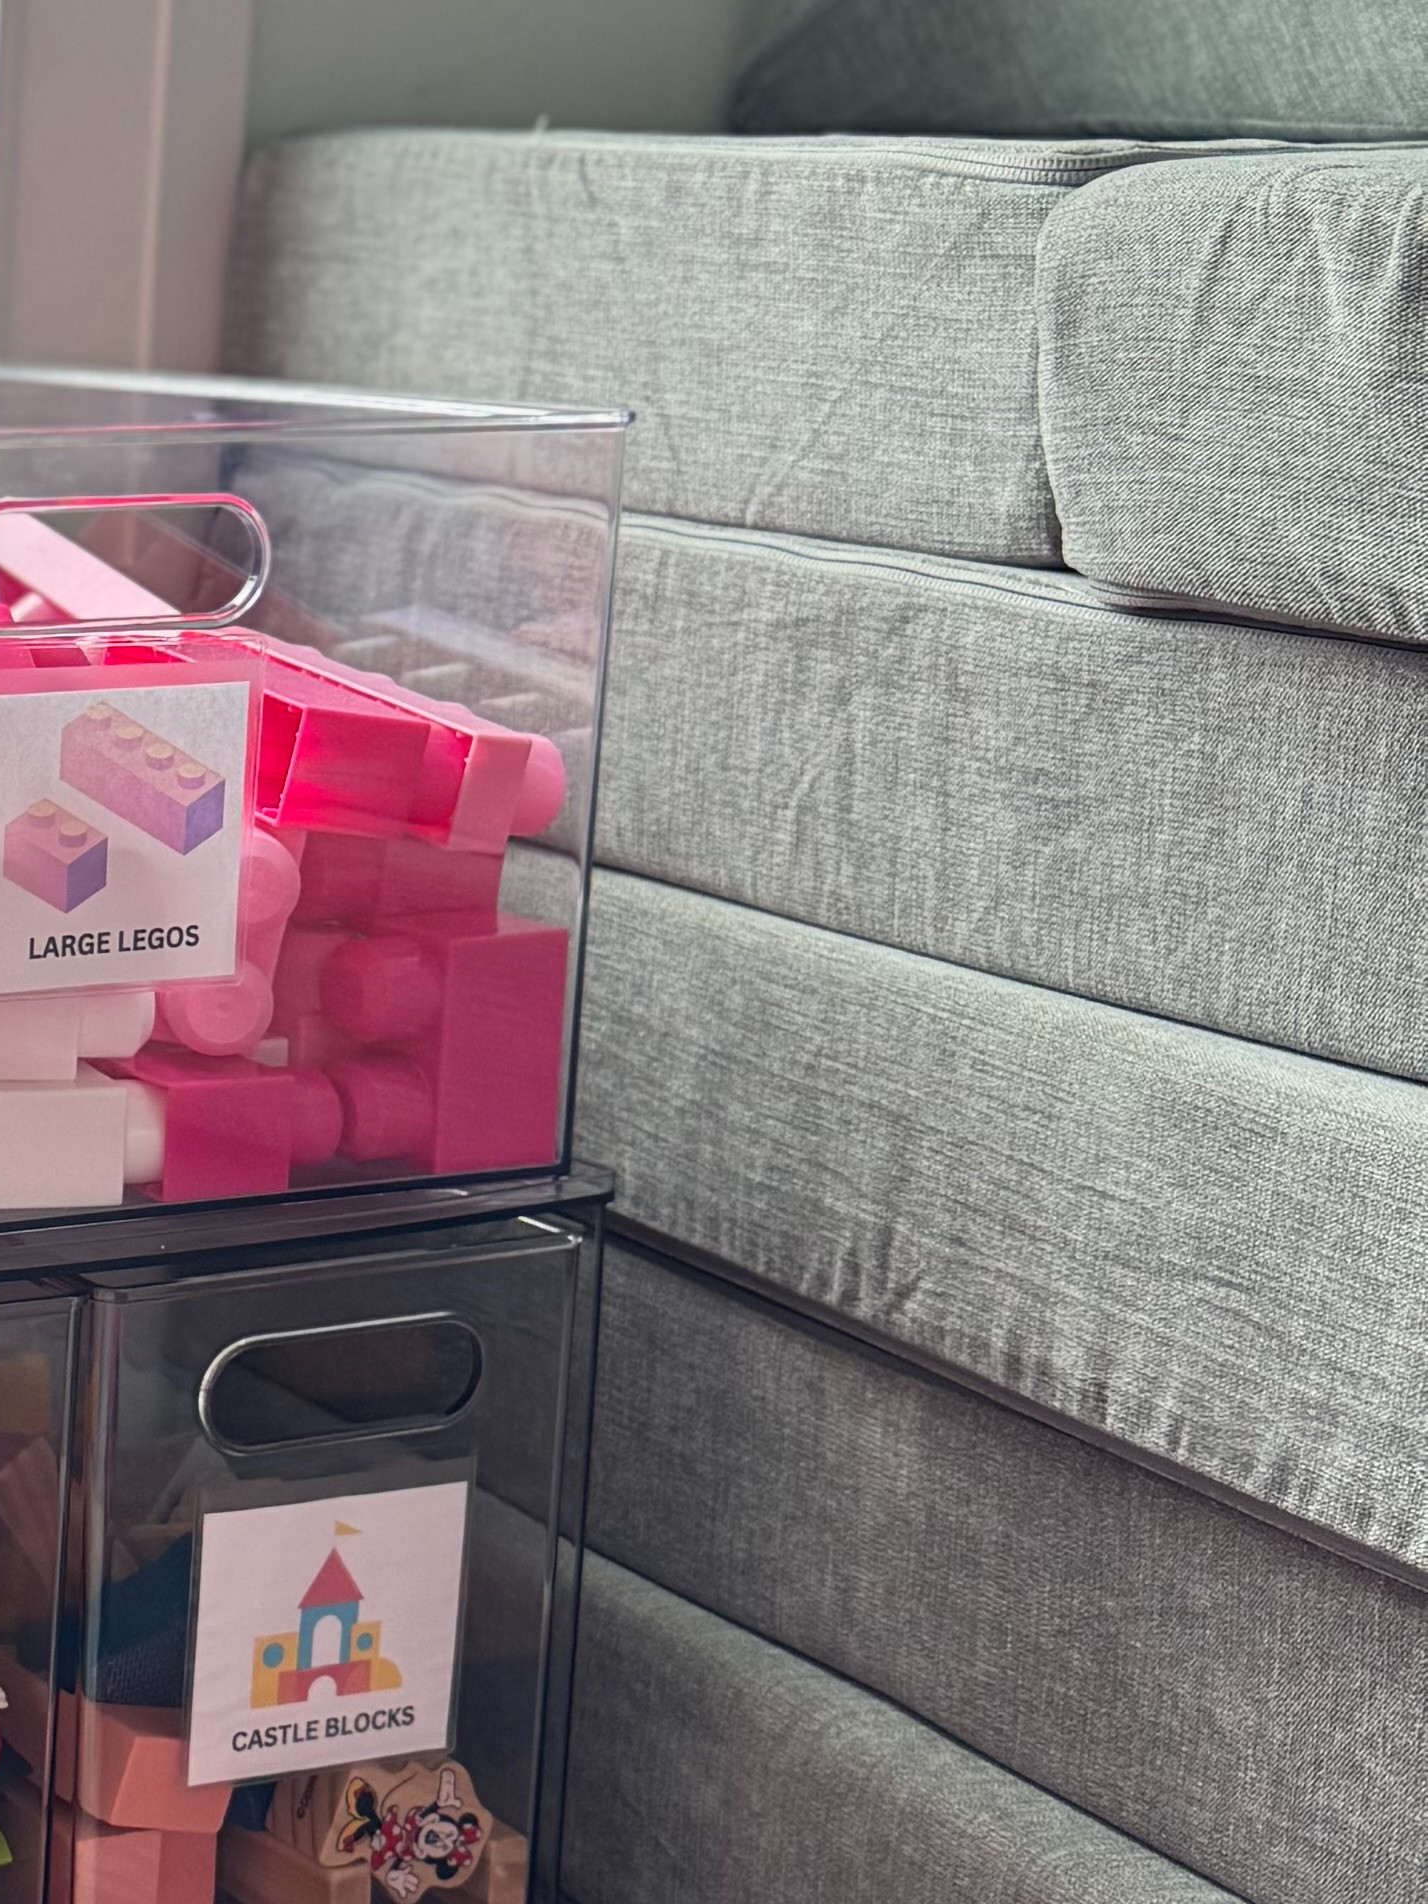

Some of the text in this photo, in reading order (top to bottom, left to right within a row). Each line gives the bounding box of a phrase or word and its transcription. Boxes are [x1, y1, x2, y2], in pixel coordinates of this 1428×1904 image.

[28, 925, 200, 960] LARGE LEGOS
[231, 1705, 415, 1752] CASTLE BLOCKS
